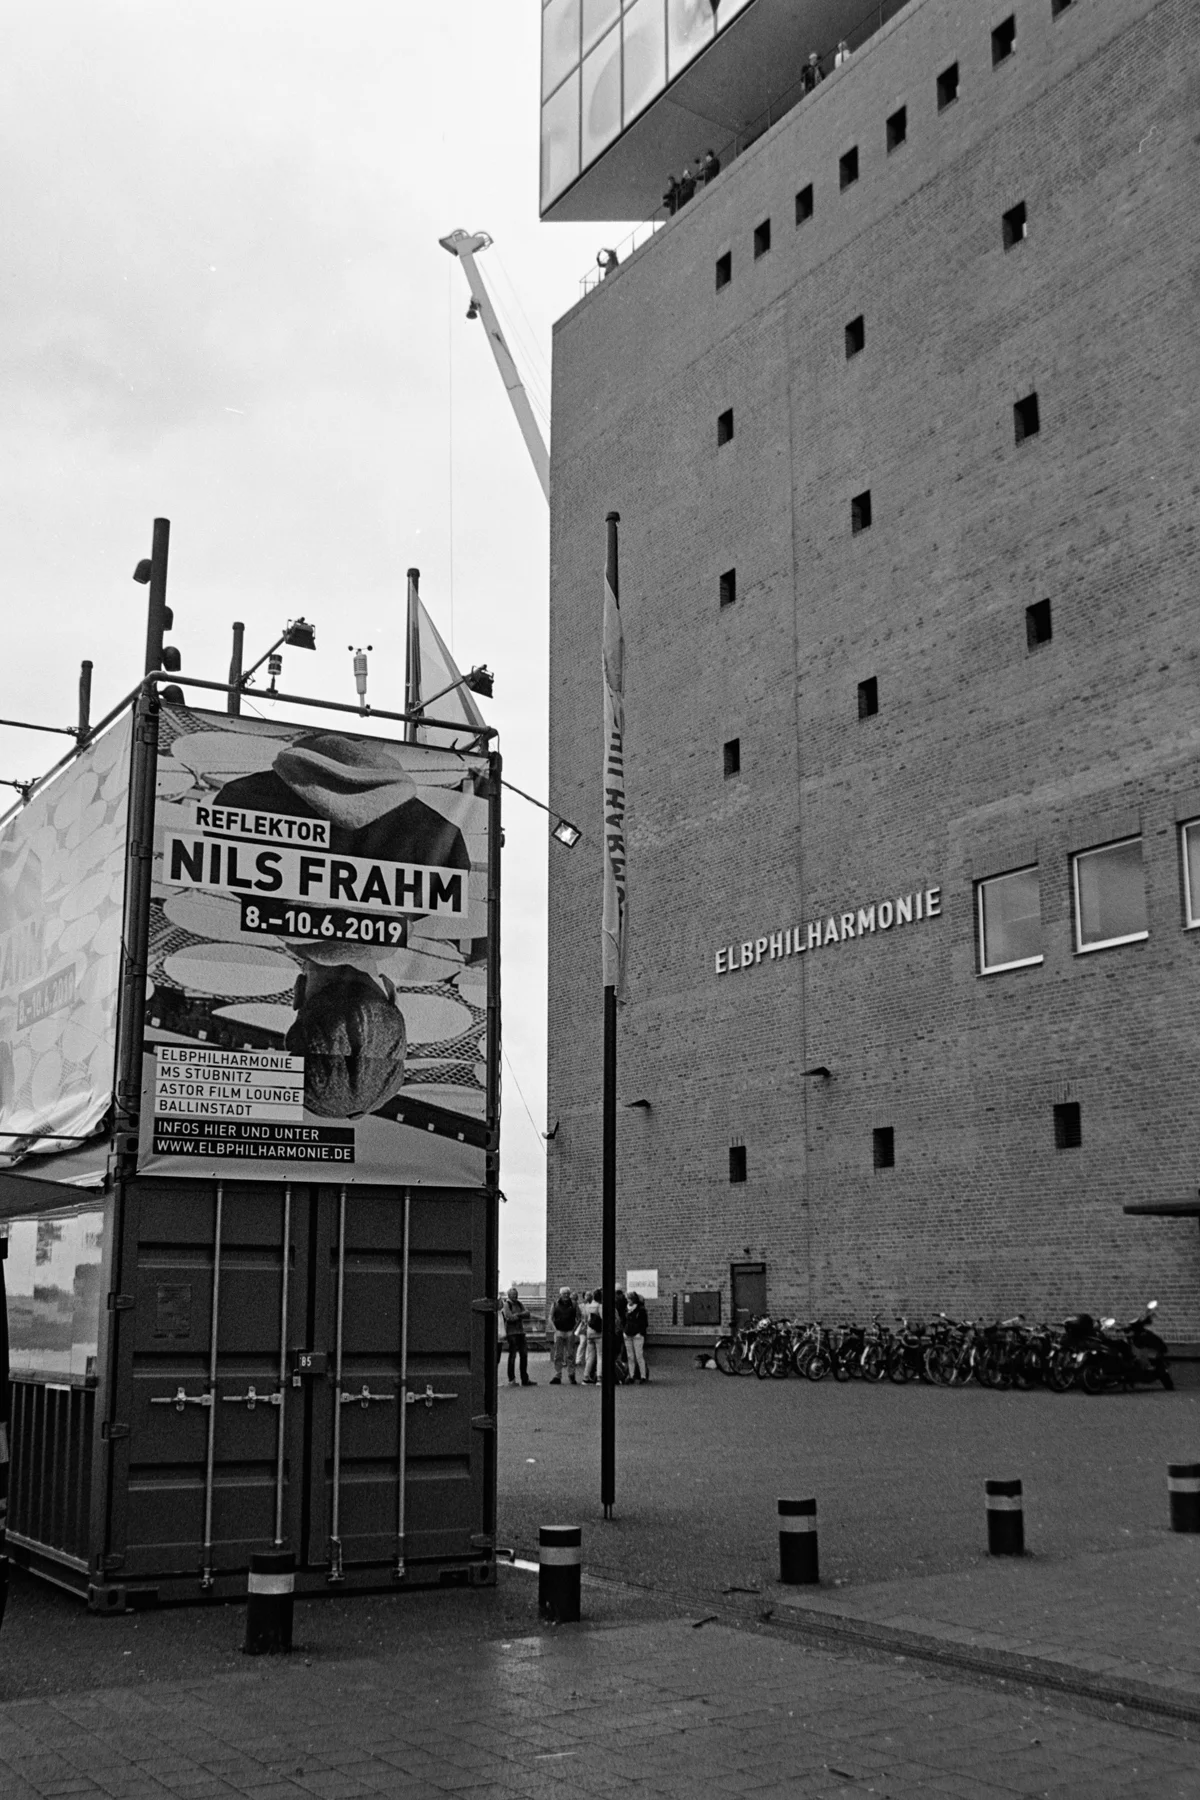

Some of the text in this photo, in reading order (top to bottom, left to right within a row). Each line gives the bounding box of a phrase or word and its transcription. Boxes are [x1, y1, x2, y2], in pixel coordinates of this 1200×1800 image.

[196, 806, 326, 843] REFLEKTOR
[170, 838, 462, 913] NILS FRAHM
[715, 886, 942, 974] ELBPHILHARMONIE
[161, 1049, 293, 1069] ELBPHILHARMONIE
[161, 1066, 252, 1083] MS STUBNITZ
[159, 1083, 300, 1102] ASTOR FILM LOUNGE
[159, 1099, 252, 1116] BALLINSTADT
[158, 1121, 319, 1141] INFOS HIER UND UNTER
[157, 1139, 351, 1160] WWW.ELBPHILHARMONIE.DE
